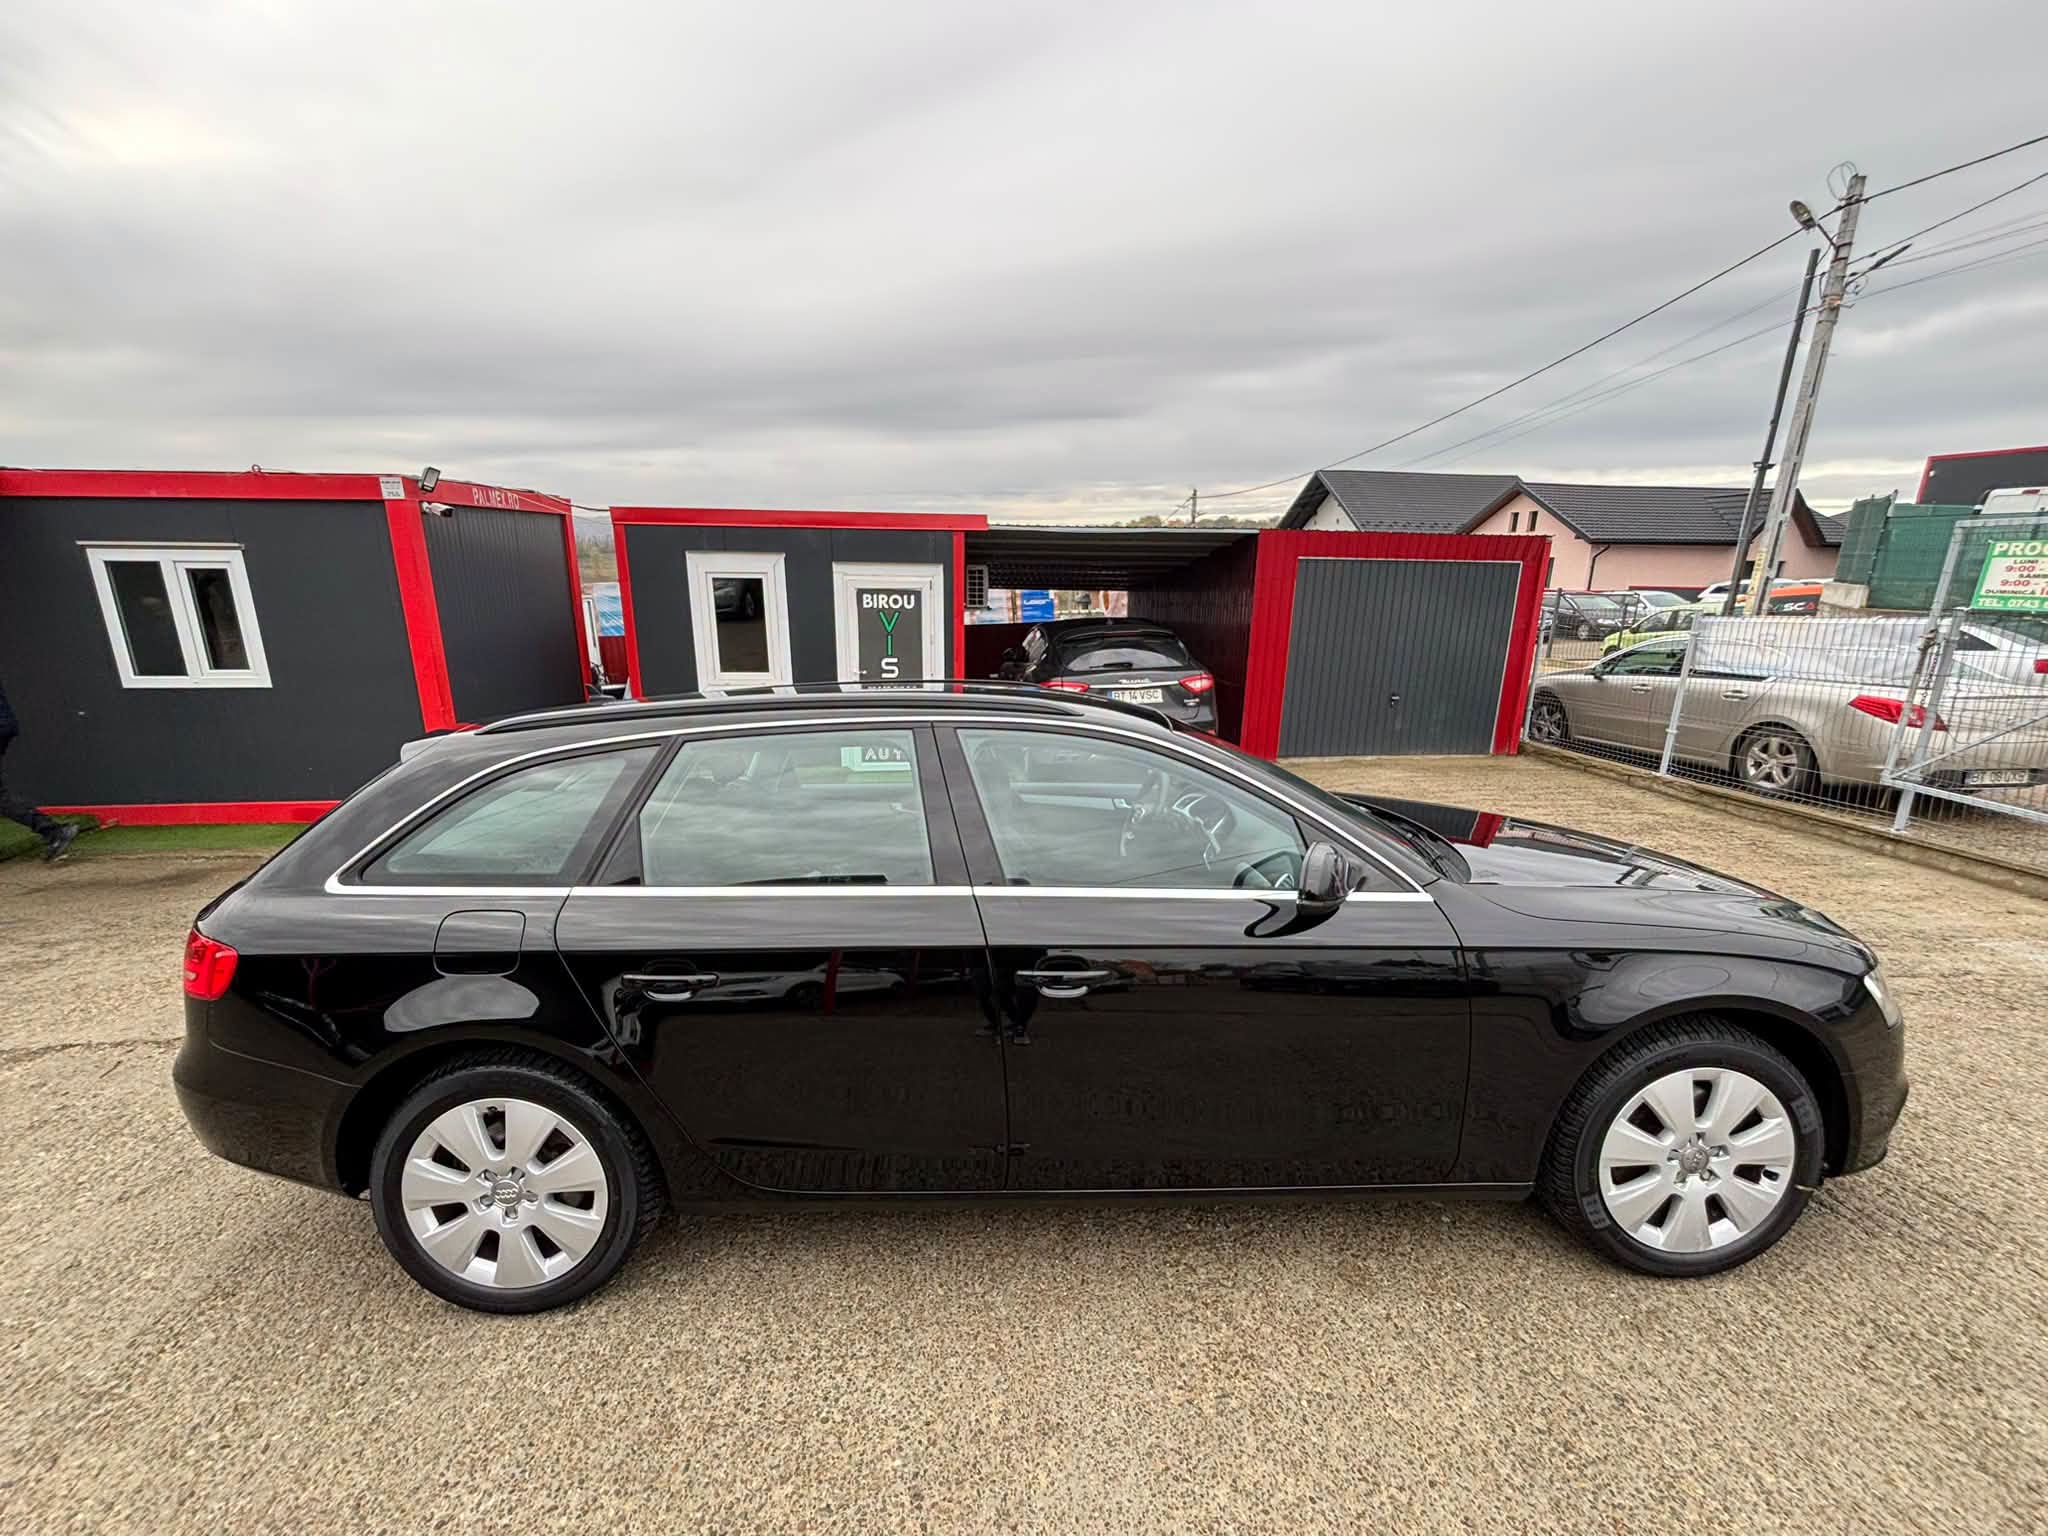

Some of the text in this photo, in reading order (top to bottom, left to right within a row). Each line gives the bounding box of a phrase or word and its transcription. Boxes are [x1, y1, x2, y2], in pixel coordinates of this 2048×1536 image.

[1999, 579, 2031, 587] 9:00
[862, 593, 915, 609] BIROU
[1128, 691, 1138, 701] 14
